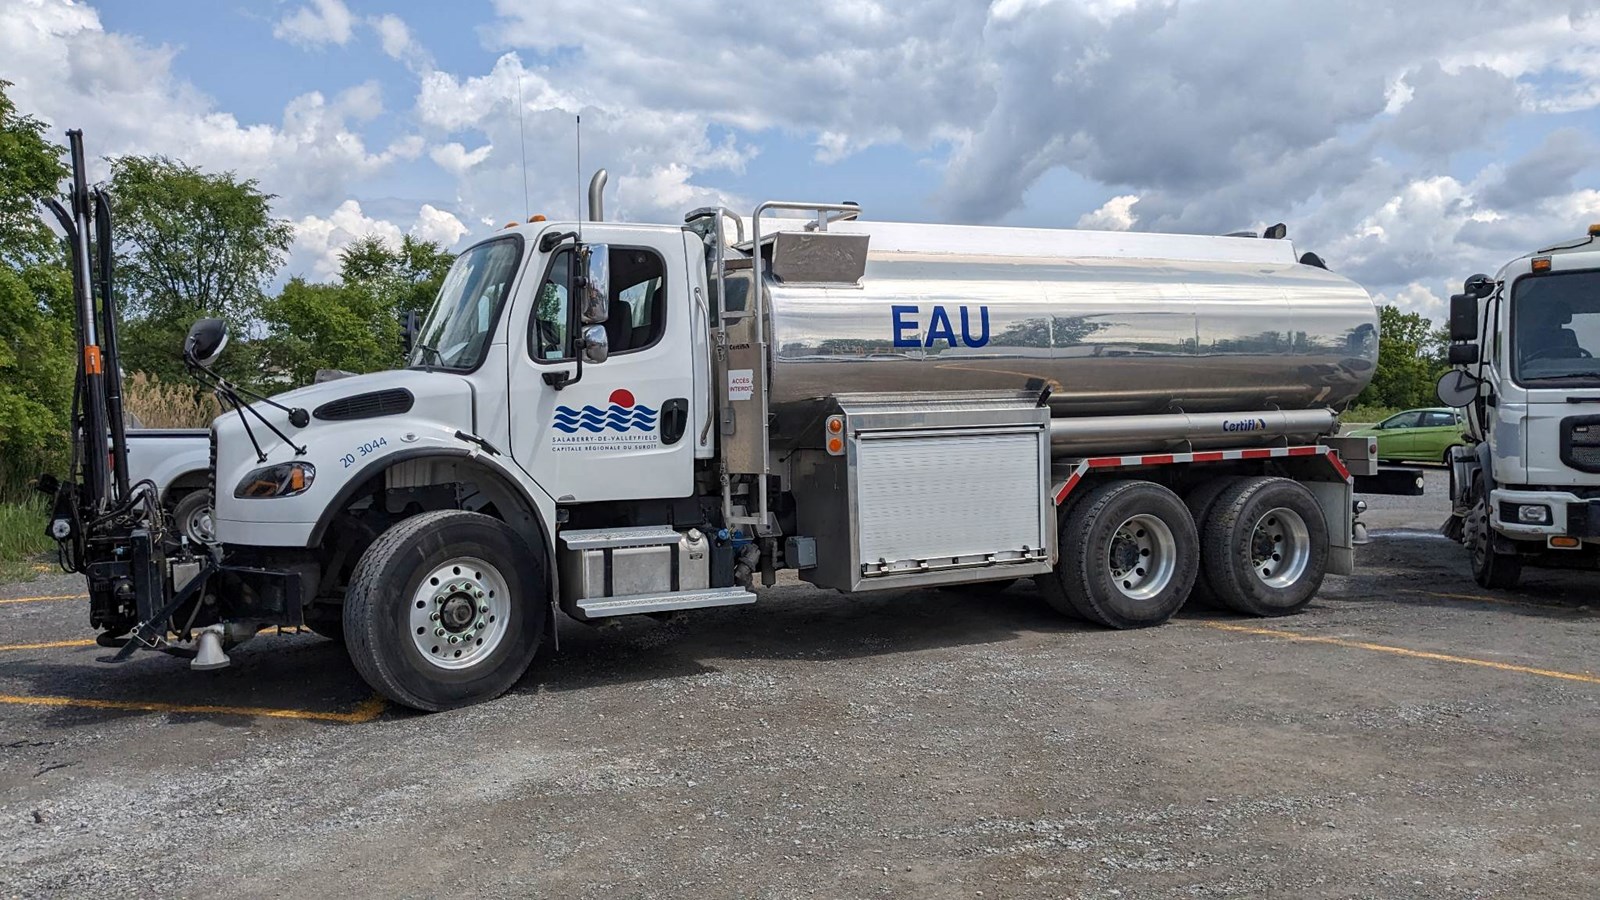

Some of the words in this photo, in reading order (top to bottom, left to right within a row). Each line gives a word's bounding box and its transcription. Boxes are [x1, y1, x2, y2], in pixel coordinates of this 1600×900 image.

[891, 305, 990, 348] EAU
[339, 453, 356, 468] 20
[357, 437, 387, 456] 3044
